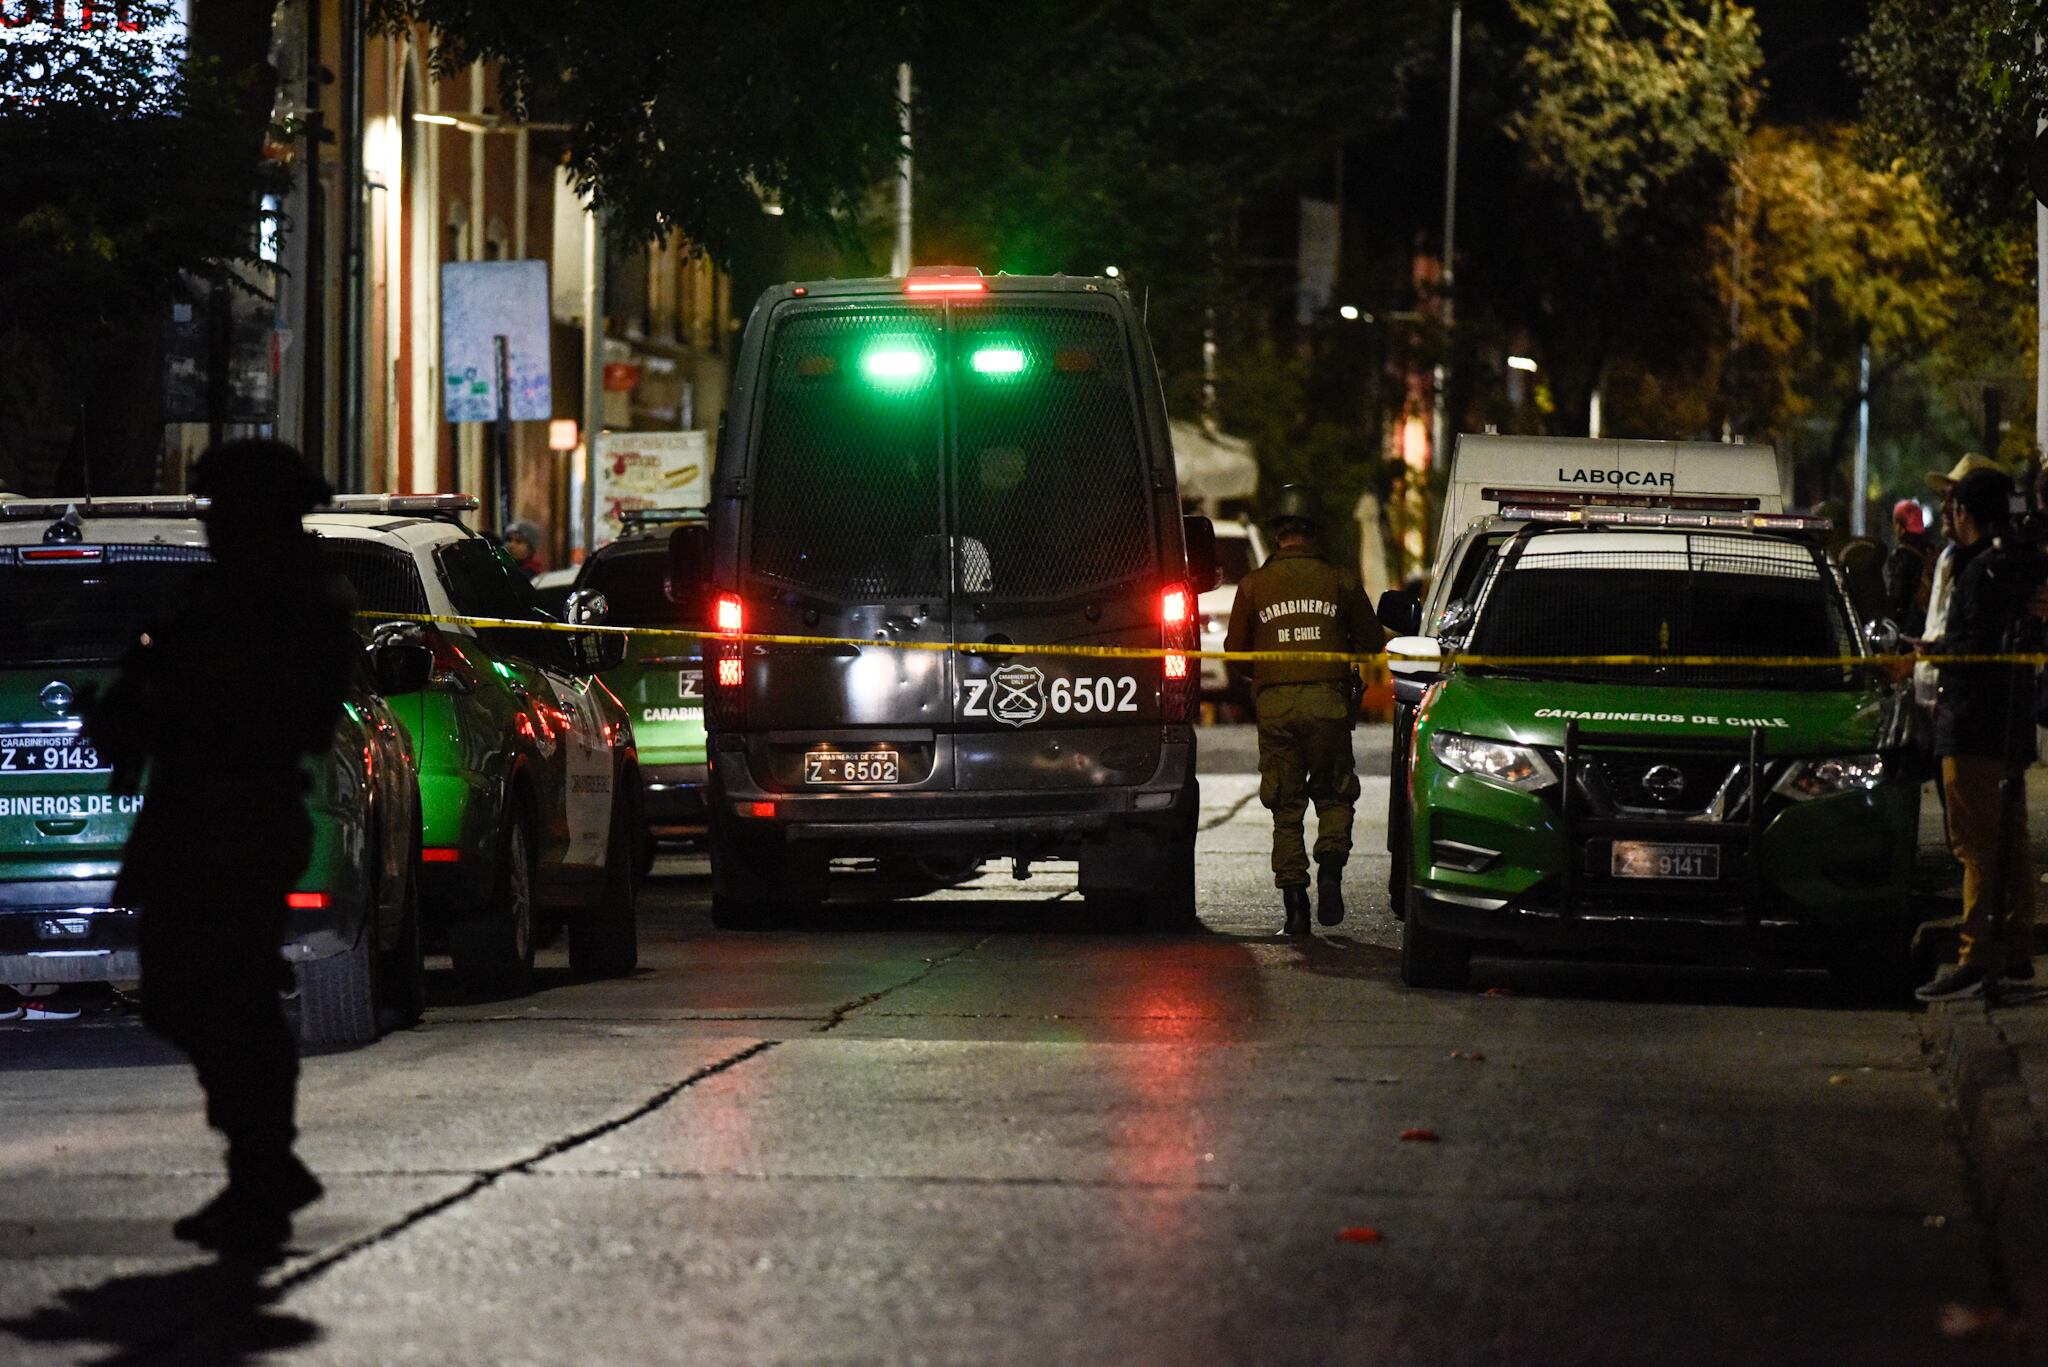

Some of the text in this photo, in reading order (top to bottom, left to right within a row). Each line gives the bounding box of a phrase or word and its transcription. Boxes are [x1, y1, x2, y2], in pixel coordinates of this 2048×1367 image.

[1558, 468, 1675, 487] LABOCAR
[1259, 599, 1337, 624] CARABINEROS
[1278, 626, 1321, 643] DE CHILE
[682, 680, 696, 696] Z
[963, 676, 1138, 717] Z 6502
[1534, 708, 1790, 728] CARABINEROS DE CHILE
[1, 738, 61, 748] CARABINEROS
[1, 747, 99, 770] Z 9143
[810, 762, 896, 781] Z 6502
[87, 795, 113, 814] DE
[1659, 856, 1703, 875] 9141
